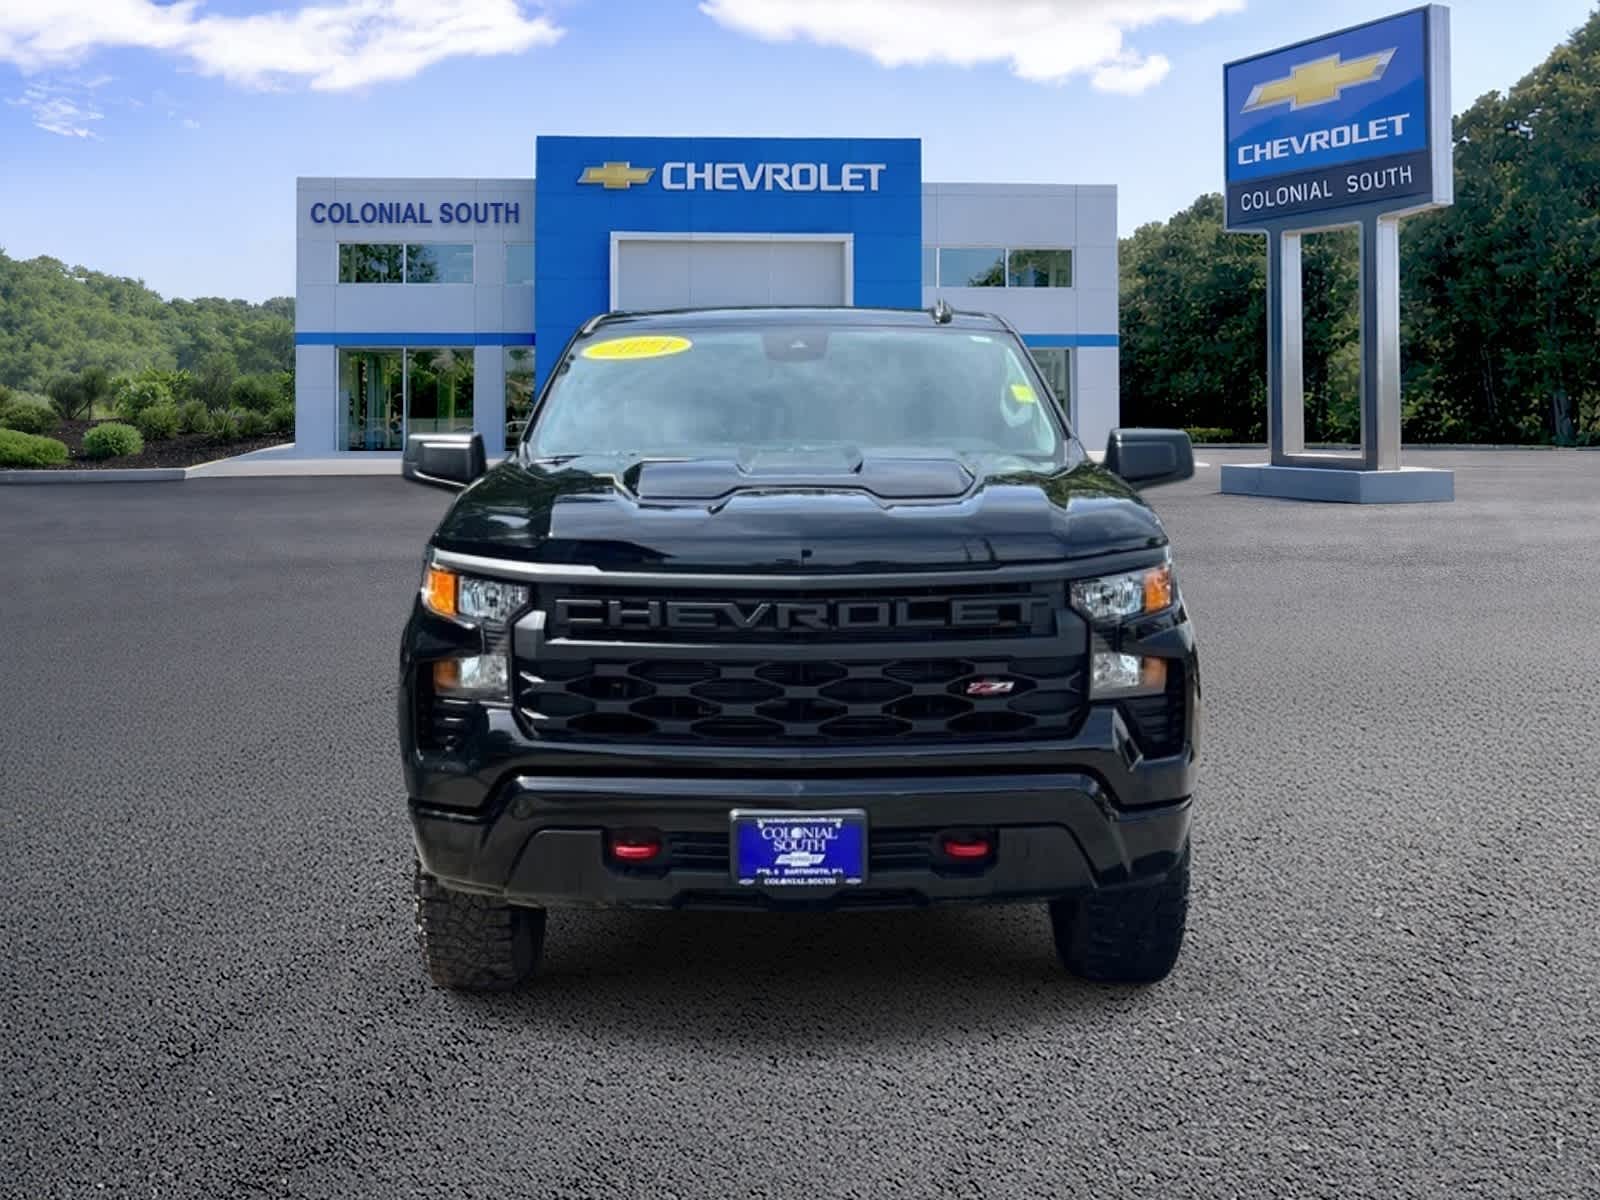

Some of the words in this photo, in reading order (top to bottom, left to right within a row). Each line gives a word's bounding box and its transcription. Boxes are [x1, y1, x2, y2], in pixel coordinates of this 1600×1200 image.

[1237, 113, 1410, 165] CHEVROLET
[661, 162, 887, 192] CHEVROLET
[1240, 180, 1333, 211] COLONIAL
[1346, 165, 1413, 194] SOUTH
[310, 202, 433, 225] COLONIAL
[439, 202, 520, 225] SOUTH
[555, 597, 1049, 629] CHEVROLET
[966, 681, 1015, 695] Z71
[761, 826, 838, 840] COLONIAL
[773, 839, 826, 852] SOUTH
